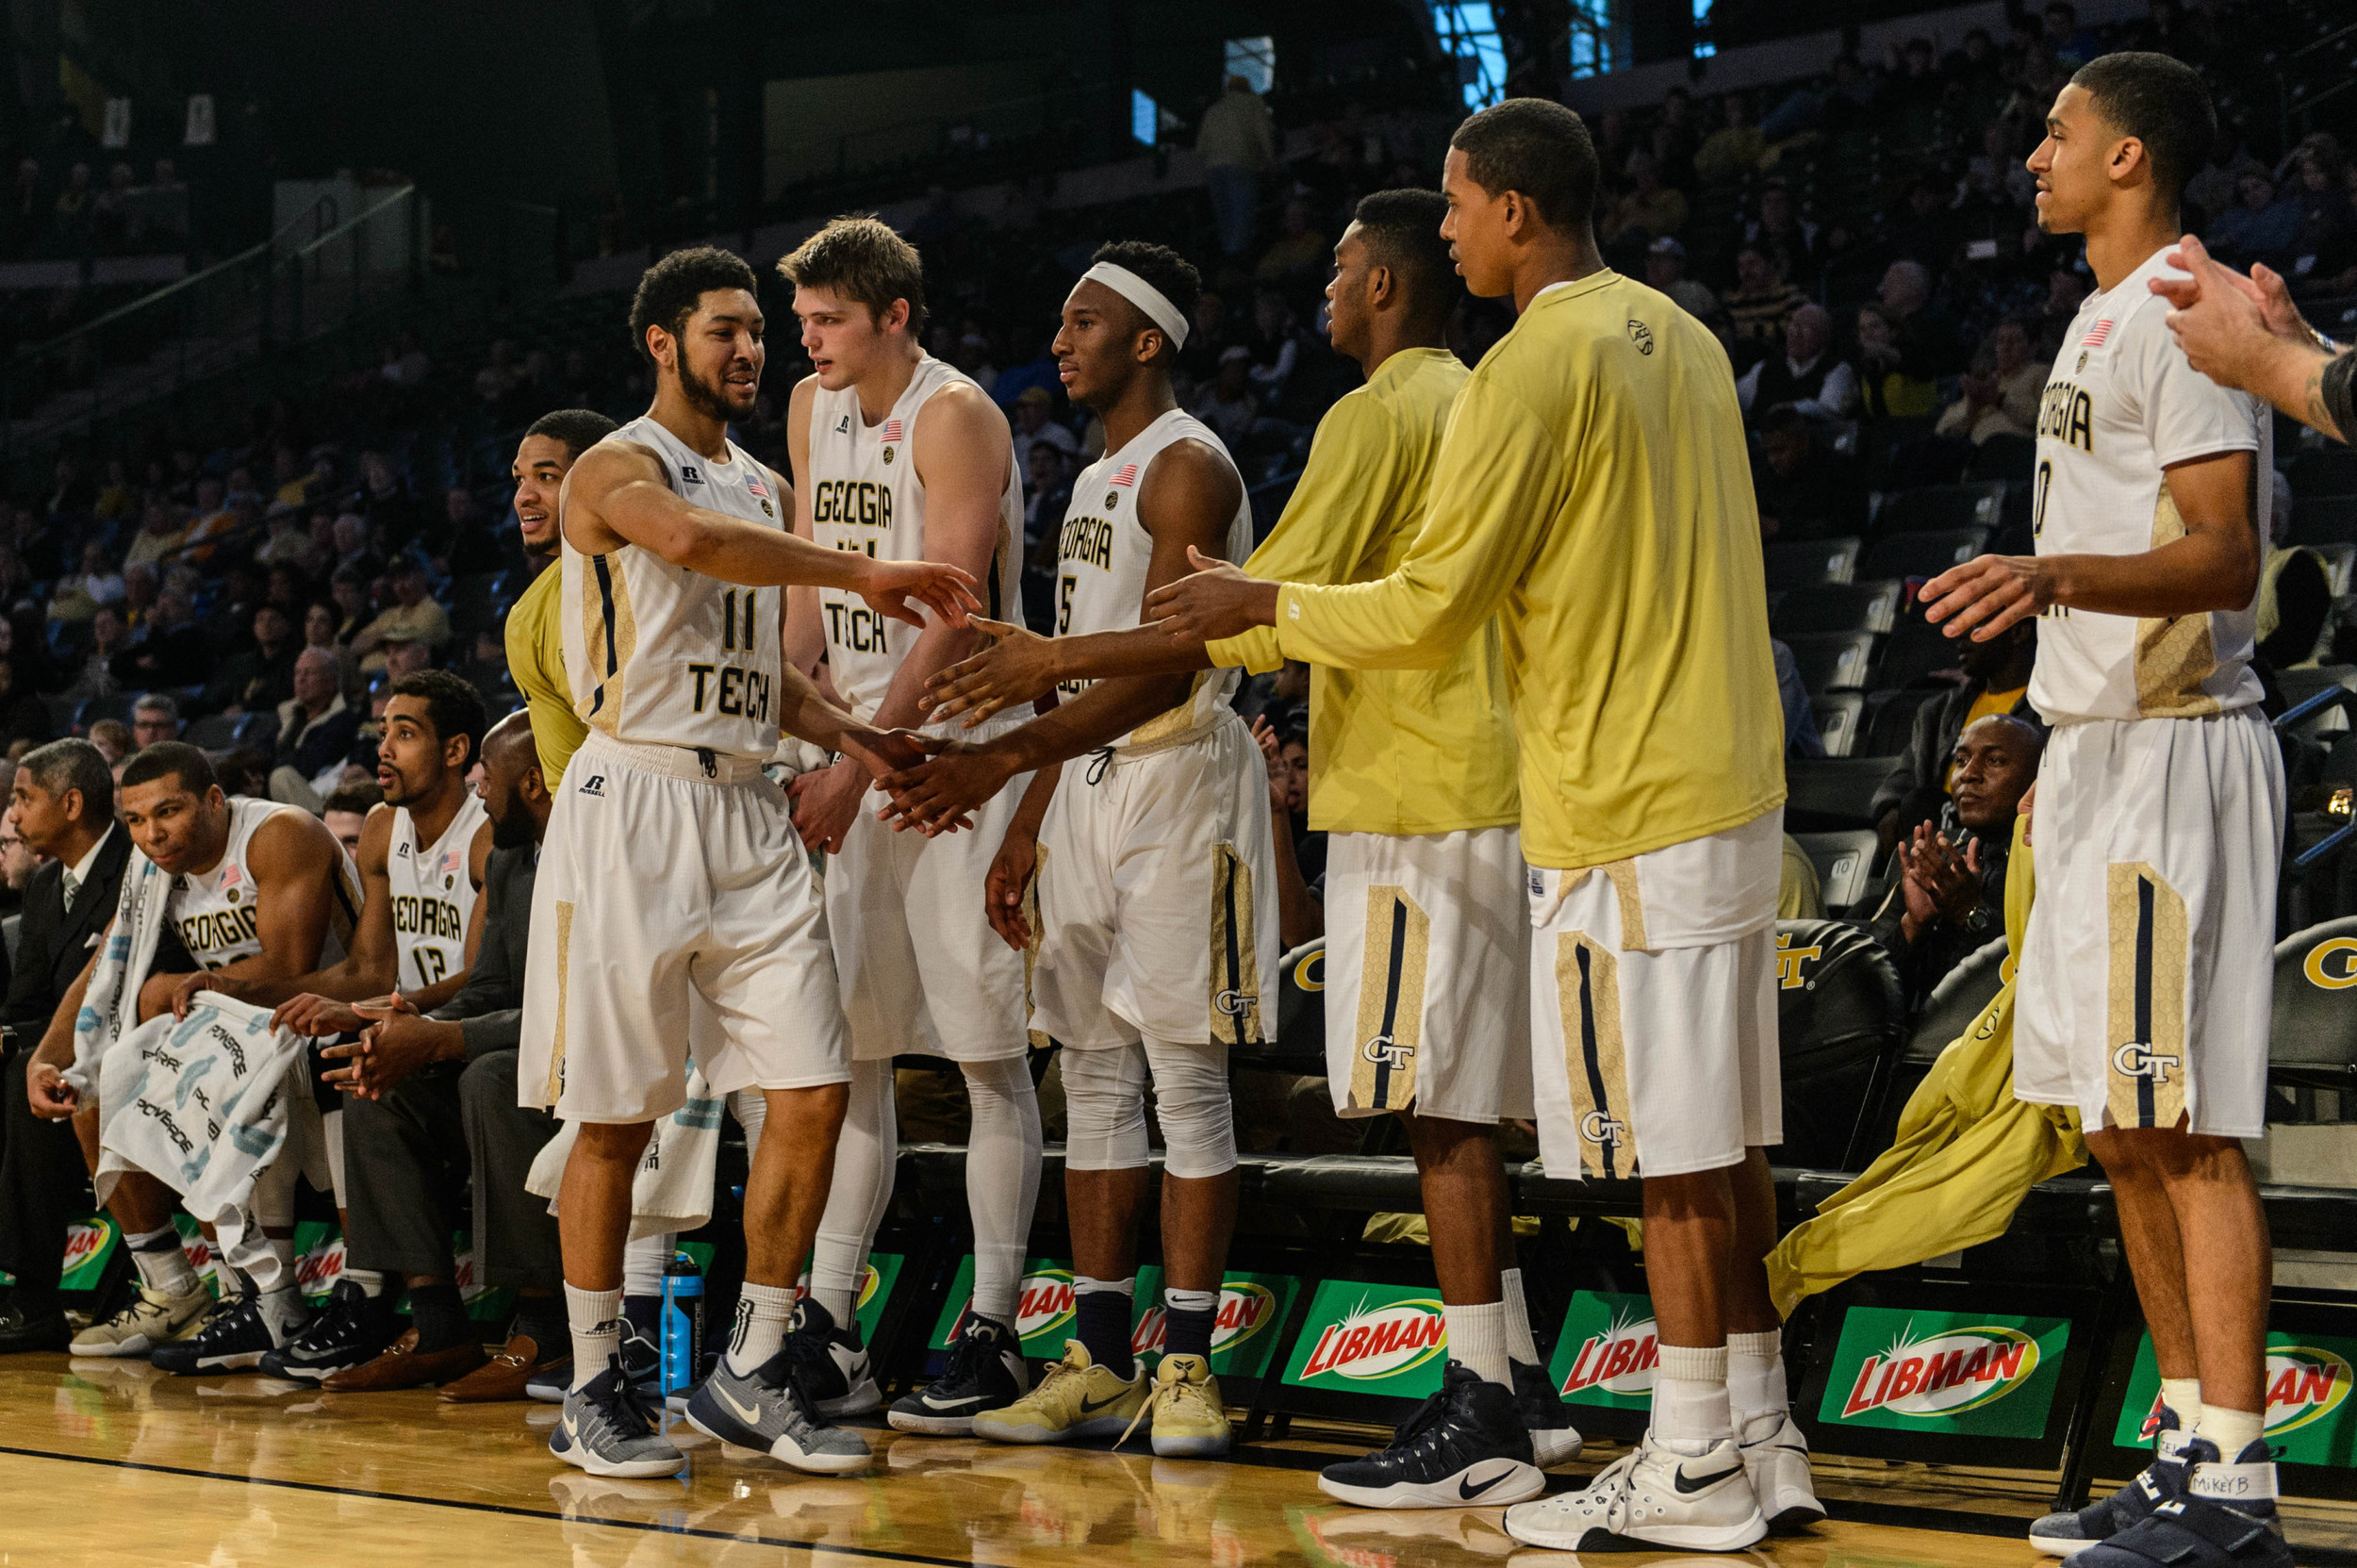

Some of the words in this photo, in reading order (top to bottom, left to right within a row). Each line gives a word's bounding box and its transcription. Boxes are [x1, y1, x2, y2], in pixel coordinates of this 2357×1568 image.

[723, 586, 756, 653] 11
[1059, 574, 1079, 636] 5
[688, 662, 770, 723] TECH
[1214, 988, 1258, 1019] GT
[1362, 1035, 1414, 1070] GT
[2112, 1041, 2180, 1083] GT
[1579, 1110, 1624, 1148] GT
[694, 1302, 702, 1380] POWERADE
[1299, 1313, 1446, 1381] LIBMAN
[1559, 1334, 1660, 1397] LIBM
[1841, 1341, 2029, 1419] LIBMAN
